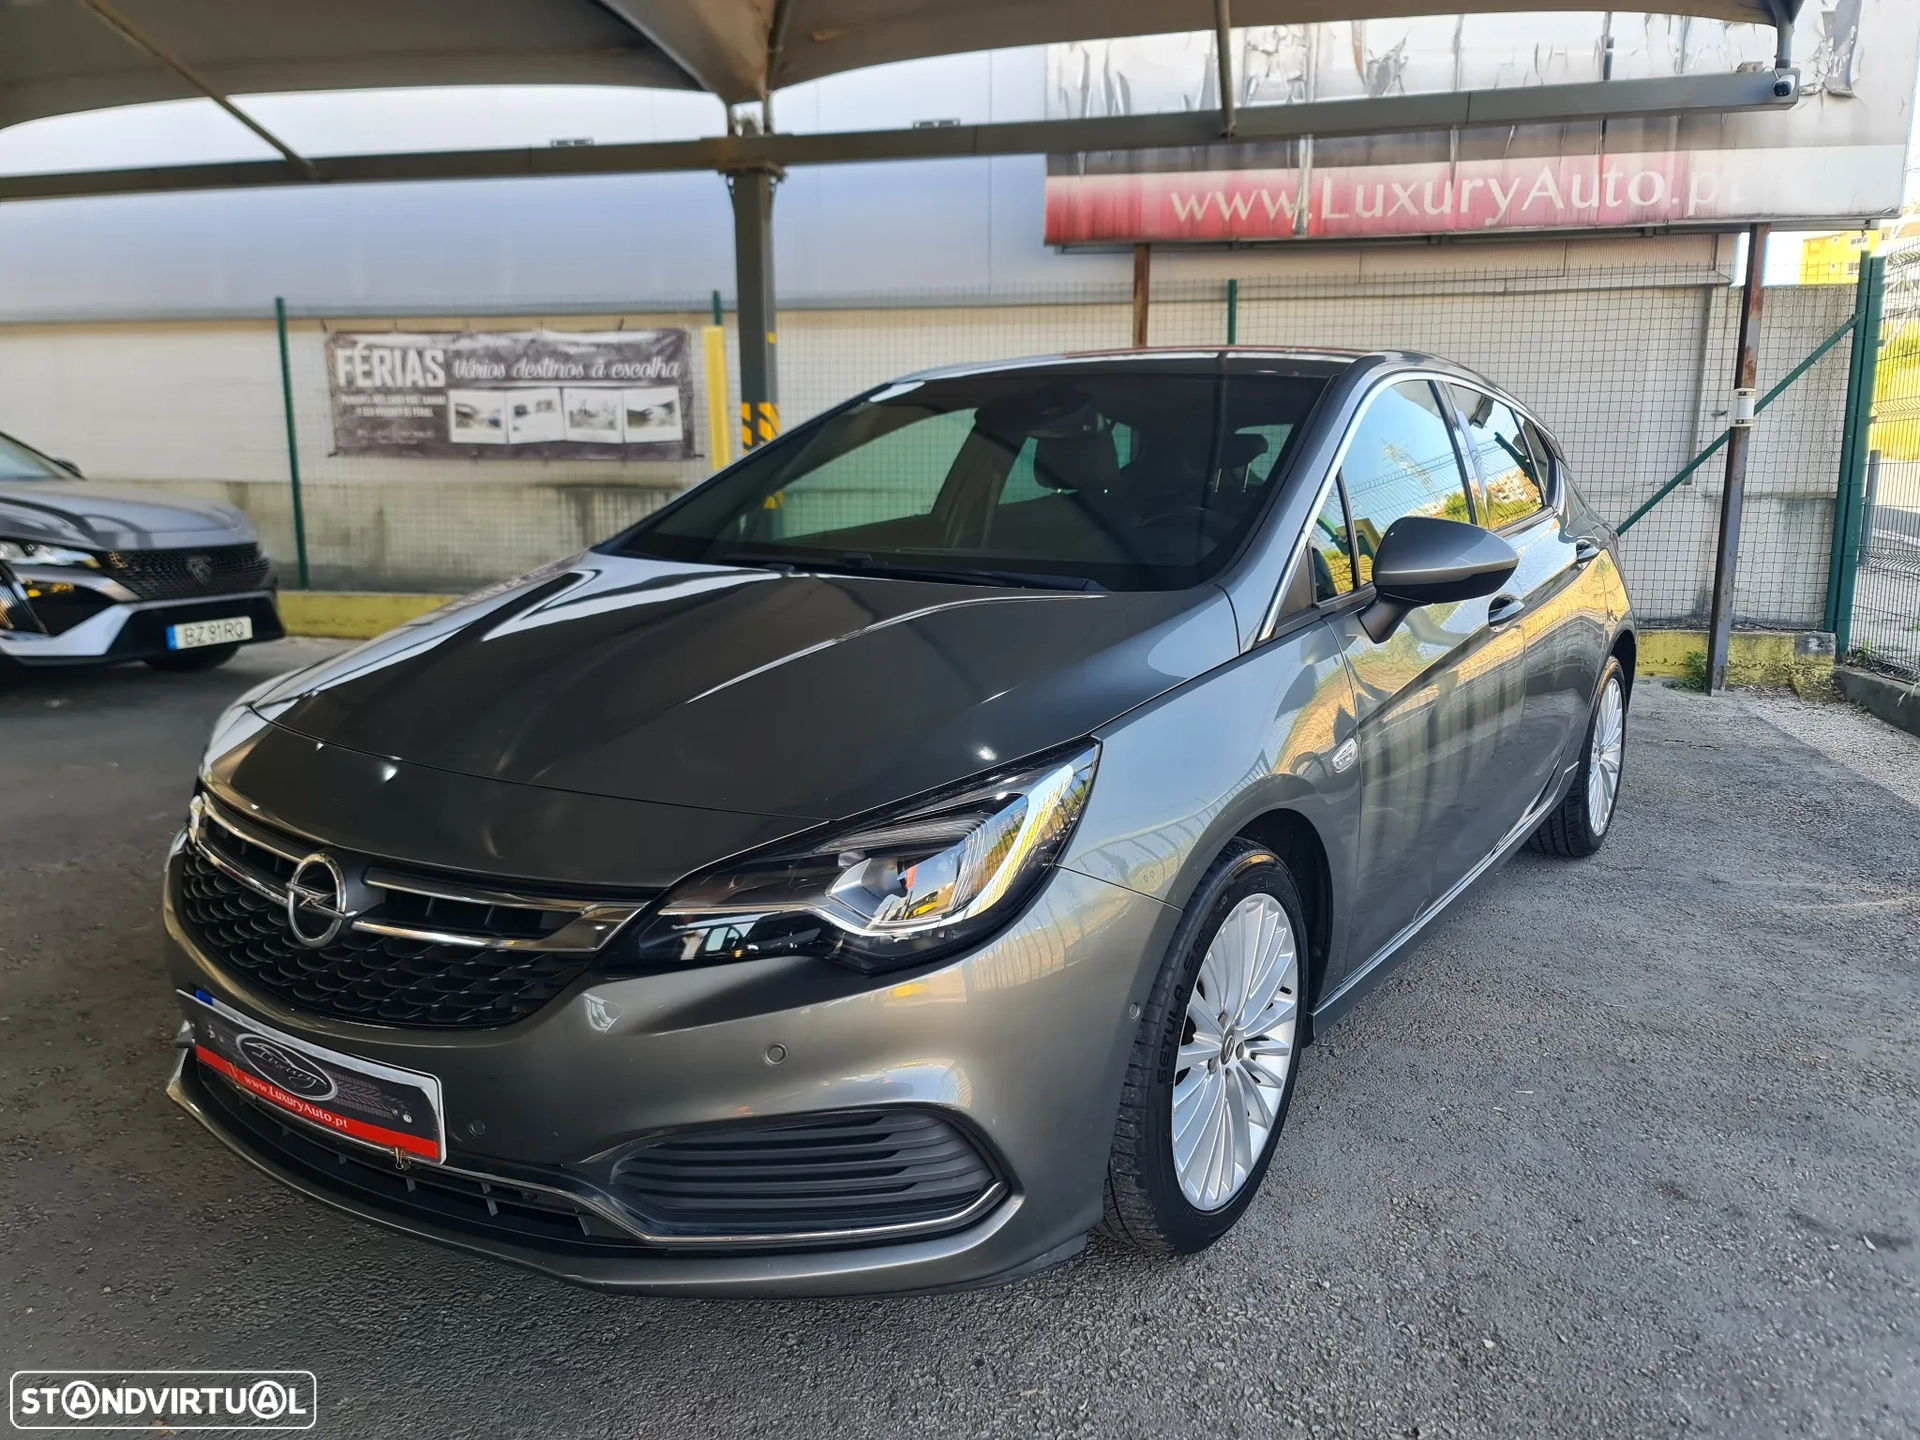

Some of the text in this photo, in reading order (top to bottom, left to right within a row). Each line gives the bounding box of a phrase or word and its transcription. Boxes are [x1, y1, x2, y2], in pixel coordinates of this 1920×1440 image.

[337, 342, 446, 388] FÉRIAS
[453, 357, 506, 380] Vários
[513, 357, 584, 379] destinos
[611, 355, 682, 379] escolha
[243, 1075, 349, 1129] www.LuxuryAuto.pt
